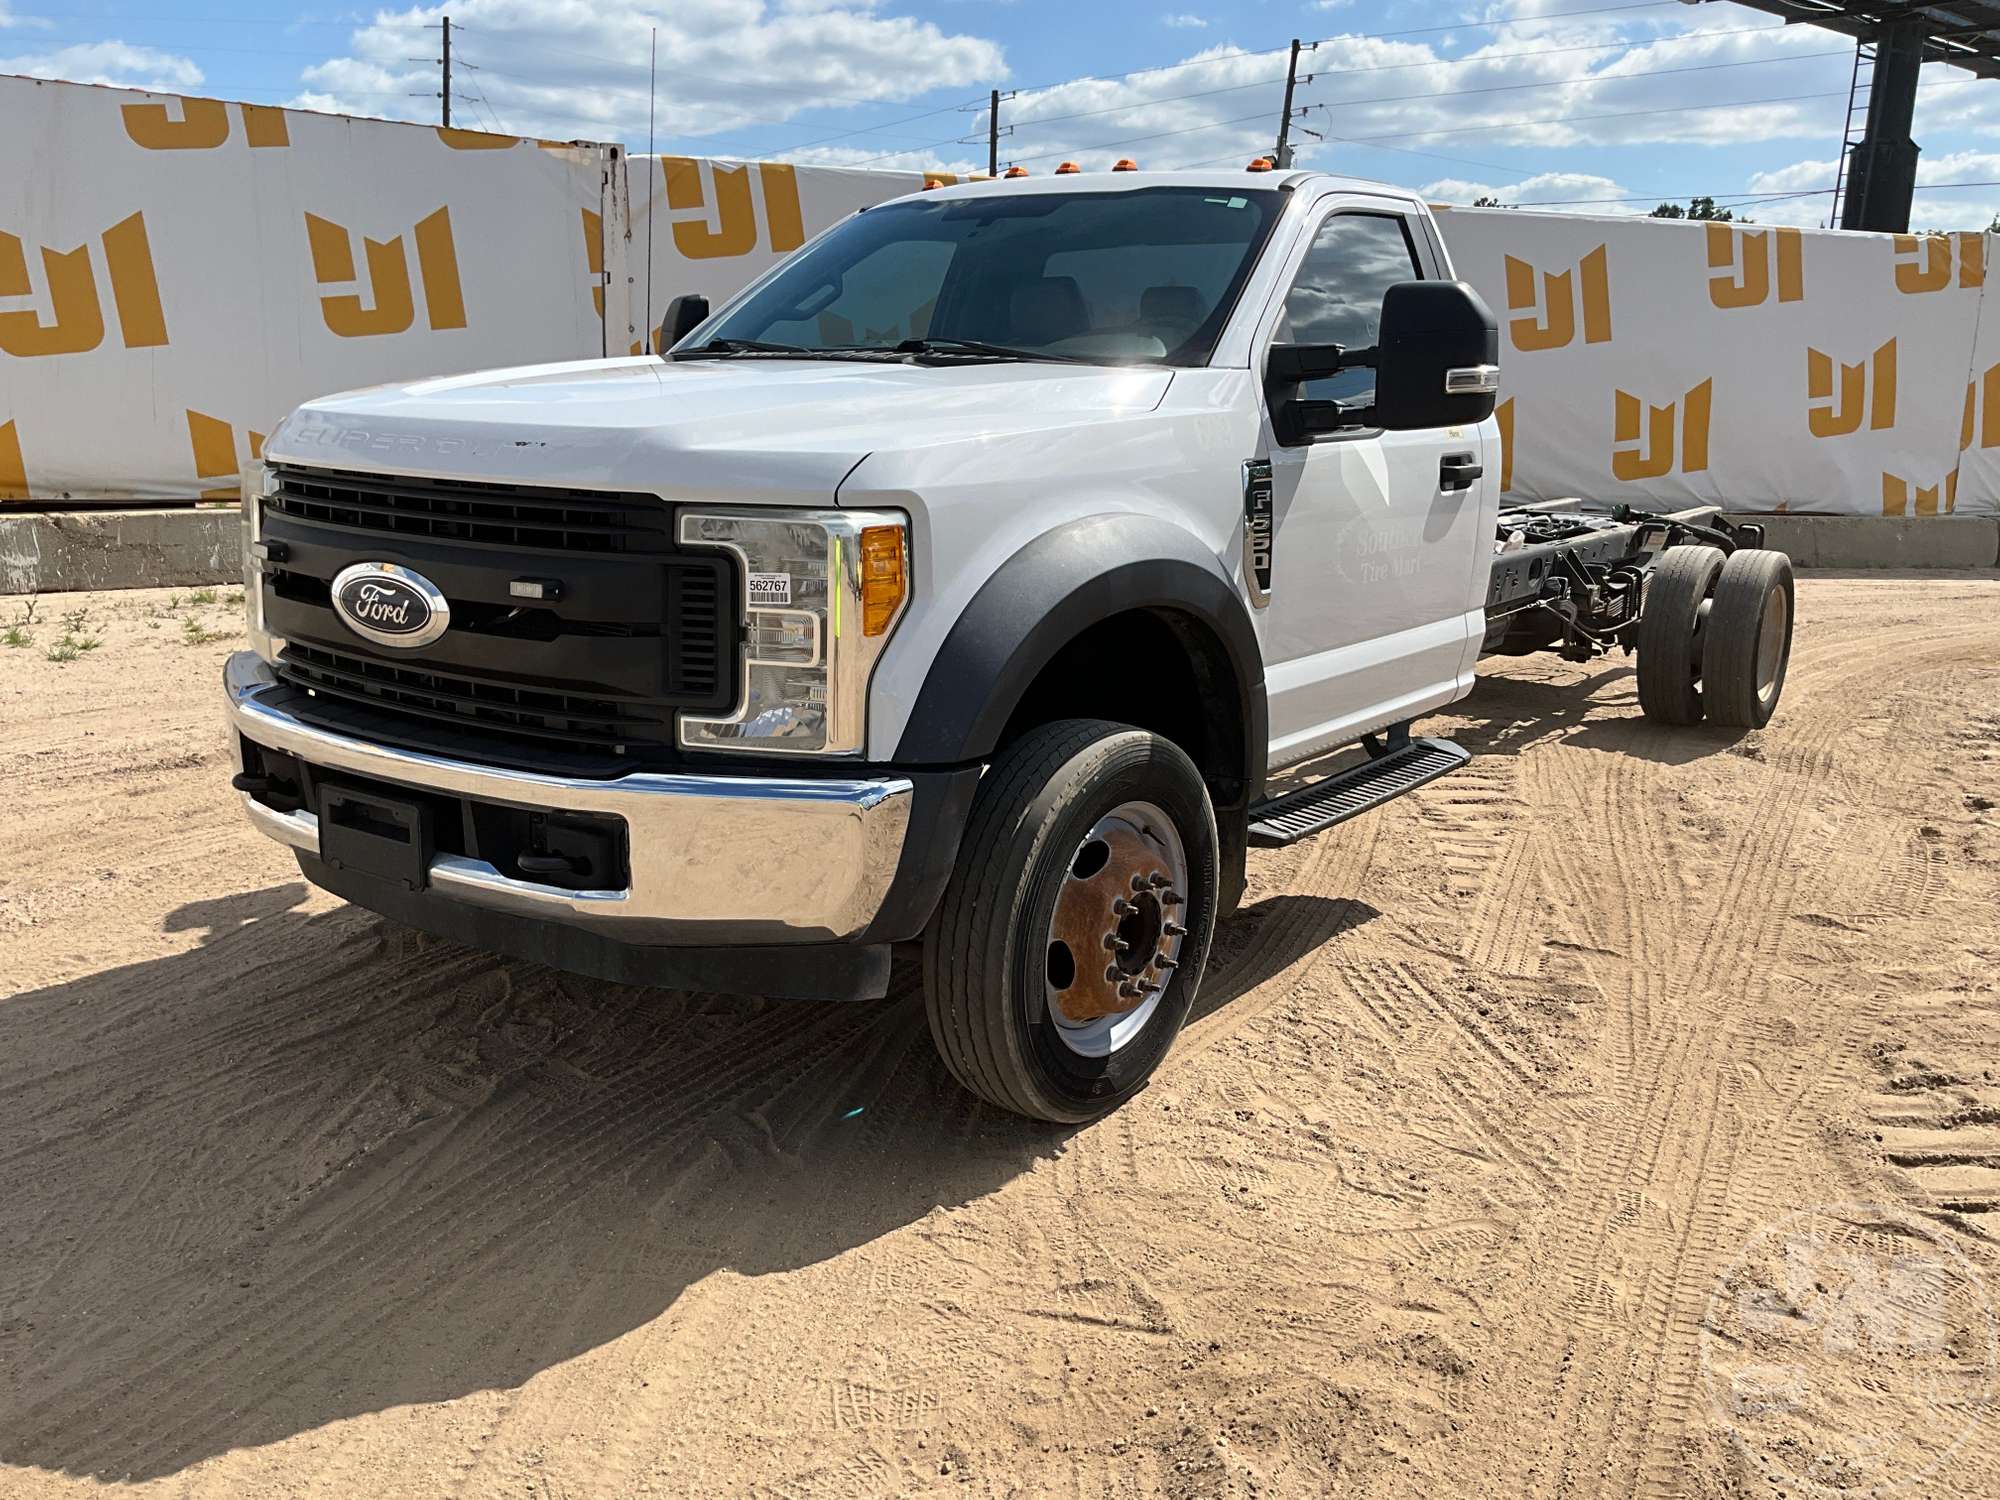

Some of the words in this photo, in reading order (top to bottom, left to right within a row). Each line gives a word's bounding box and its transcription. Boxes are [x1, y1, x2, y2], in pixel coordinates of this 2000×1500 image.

[294, 427, 426, 454] SUPER
[749, 580, 787, 592] 562767
[356, 583, 409, 625] Ford
